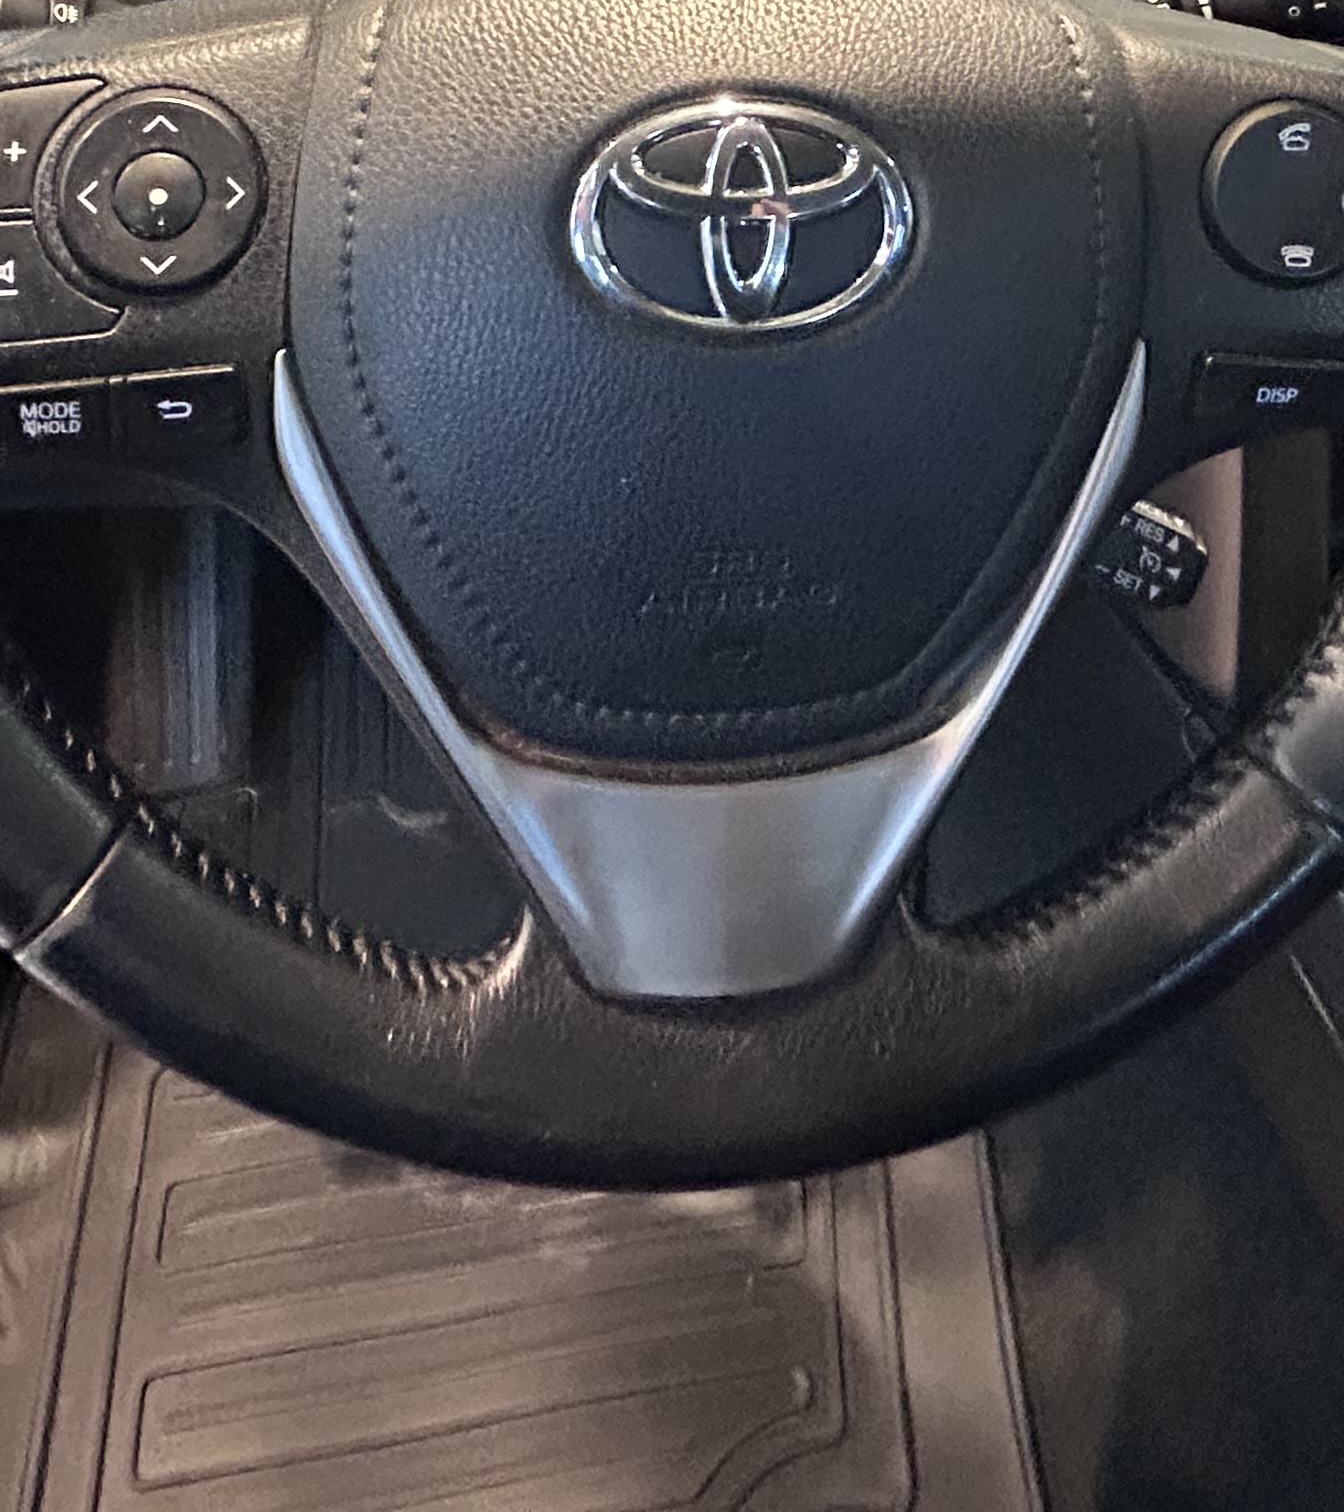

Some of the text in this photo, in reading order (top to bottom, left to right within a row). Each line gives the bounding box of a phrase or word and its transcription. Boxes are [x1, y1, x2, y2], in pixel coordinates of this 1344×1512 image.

[1256, 387, 1299, 403] DISP
[19, 401, 82, 419] MODE
[36, 419, 82, 436] HOLD
[1135, 517, 1165, 544] RES
